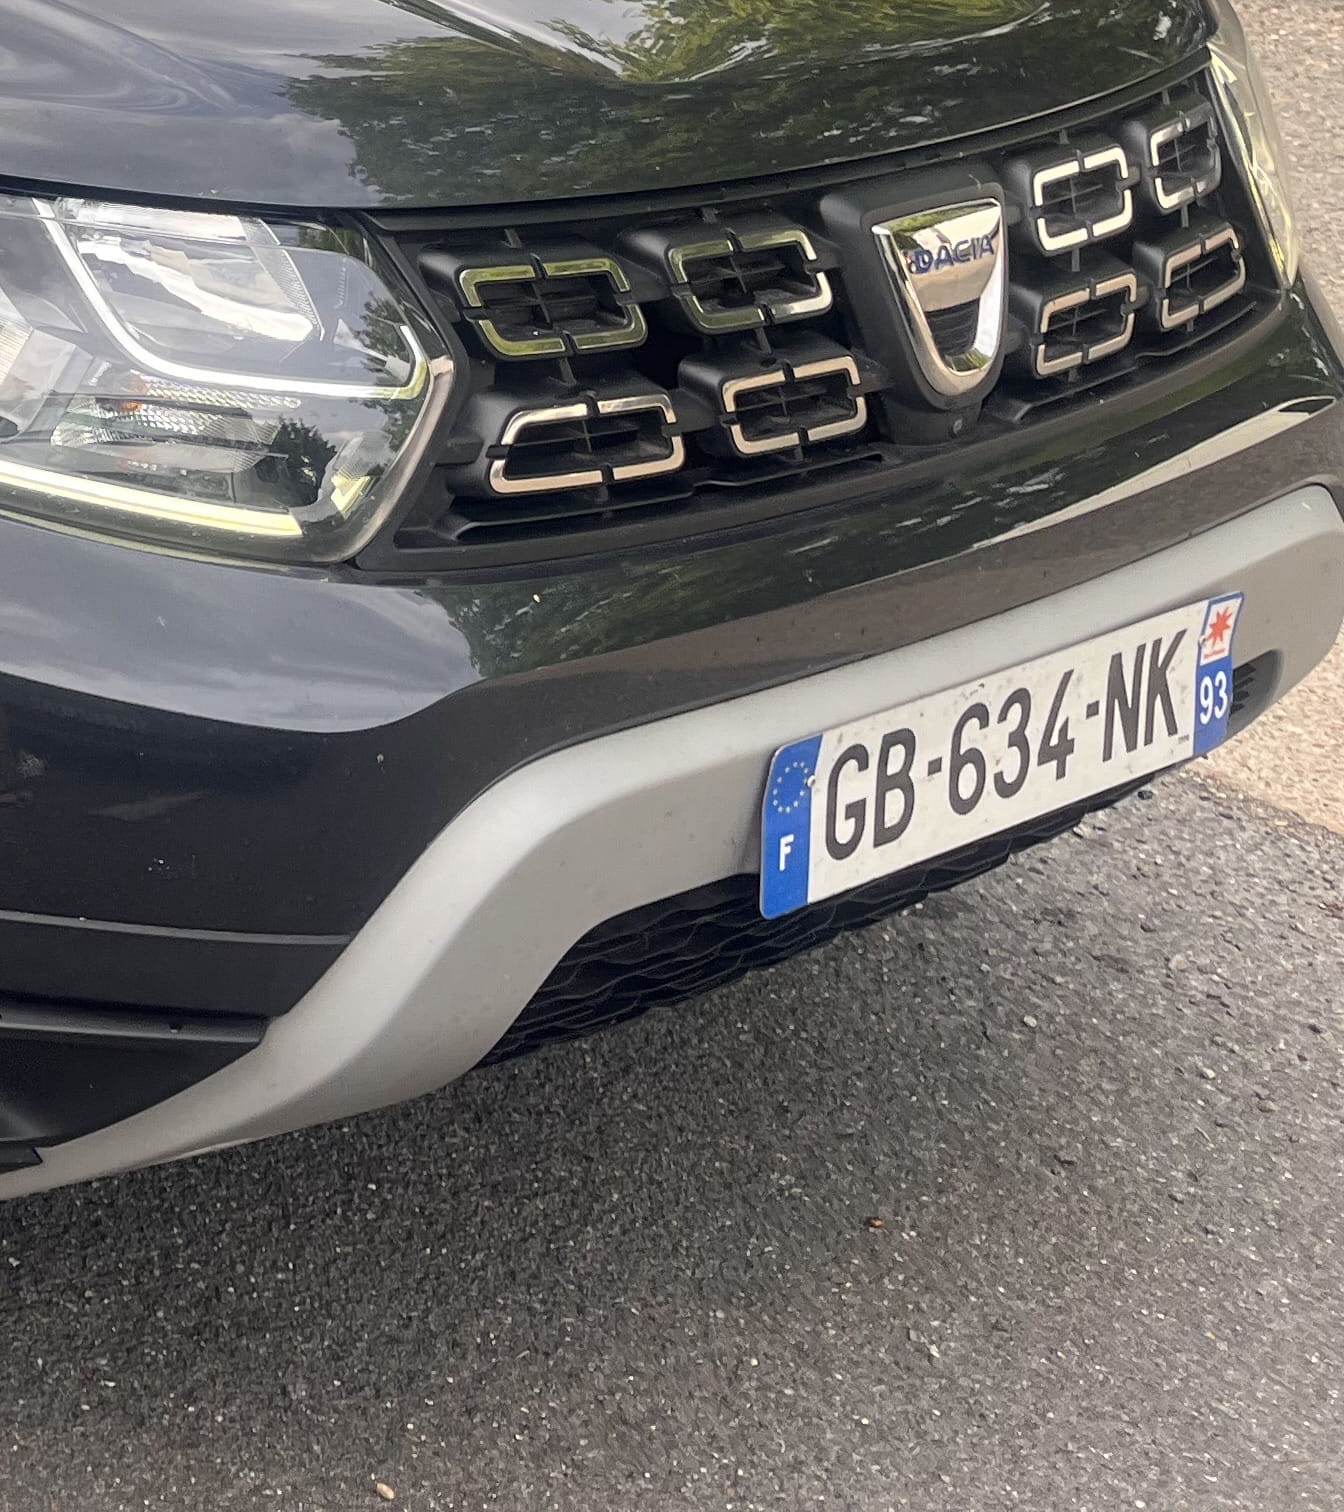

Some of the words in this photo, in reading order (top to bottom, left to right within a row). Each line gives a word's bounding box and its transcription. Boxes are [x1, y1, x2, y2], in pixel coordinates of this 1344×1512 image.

[914, 234, 994, 274] DACIA
[1199, 670, 1228, 725] 93
[825, 629, 1189, 860] GB-634-NK
[778, 833, 794, 871] F
